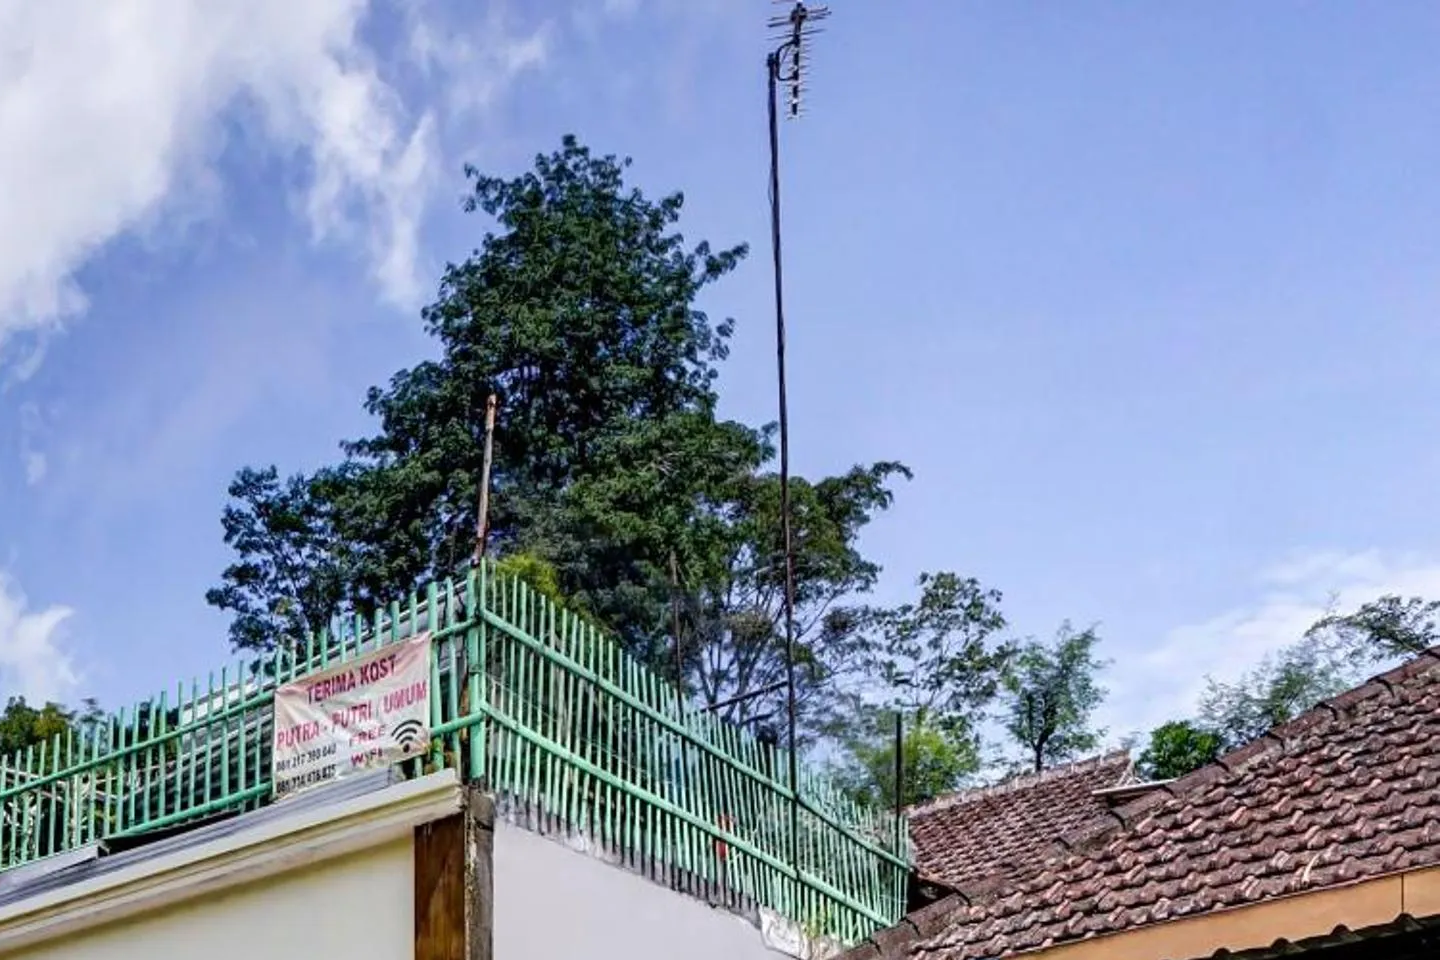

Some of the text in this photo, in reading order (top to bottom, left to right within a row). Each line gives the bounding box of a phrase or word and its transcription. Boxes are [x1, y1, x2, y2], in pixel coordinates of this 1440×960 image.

[307, 654, 397, 704] TERIMA KOST
[277, 720, 320, 750] PUTRA
[332, 704, 372, 732] PUTRI
[383, 680, 427, 715] UMUM
[349, 725, 386, 747] FREE
